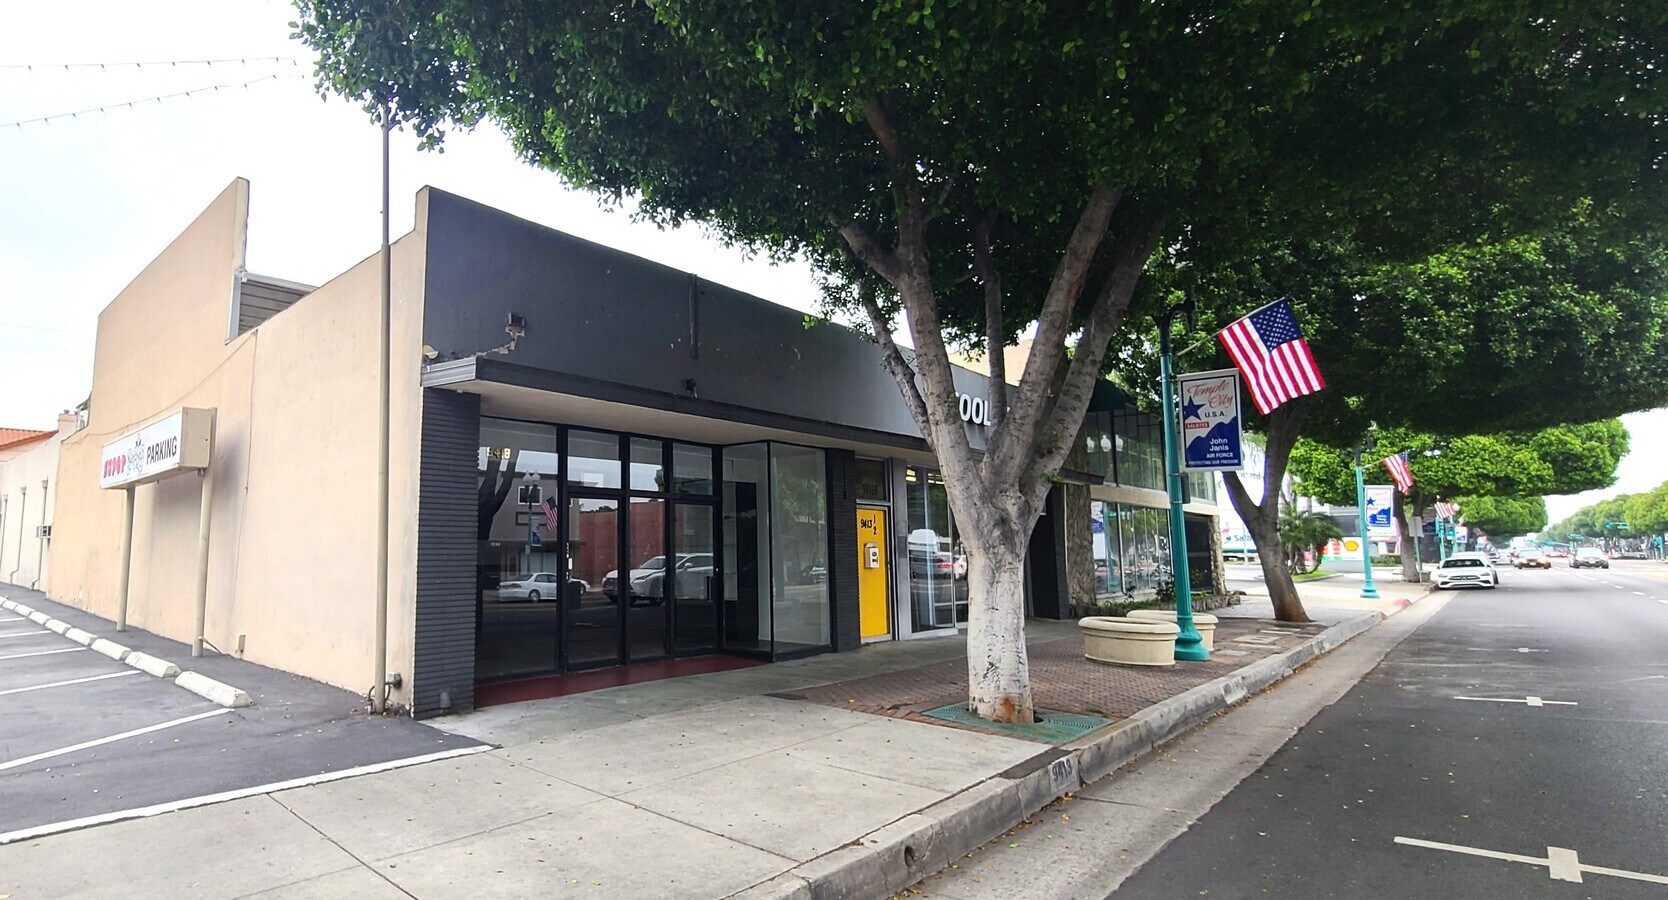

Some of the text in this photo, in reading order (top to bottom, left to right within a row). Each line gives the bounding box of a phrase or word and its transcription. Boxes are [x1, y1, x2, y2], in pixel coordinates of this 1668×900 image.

[1187, 380, 1230, 398] Temple
[1208, 394, 1234, 408] City
[146, 436, 178, 465] PARKING
